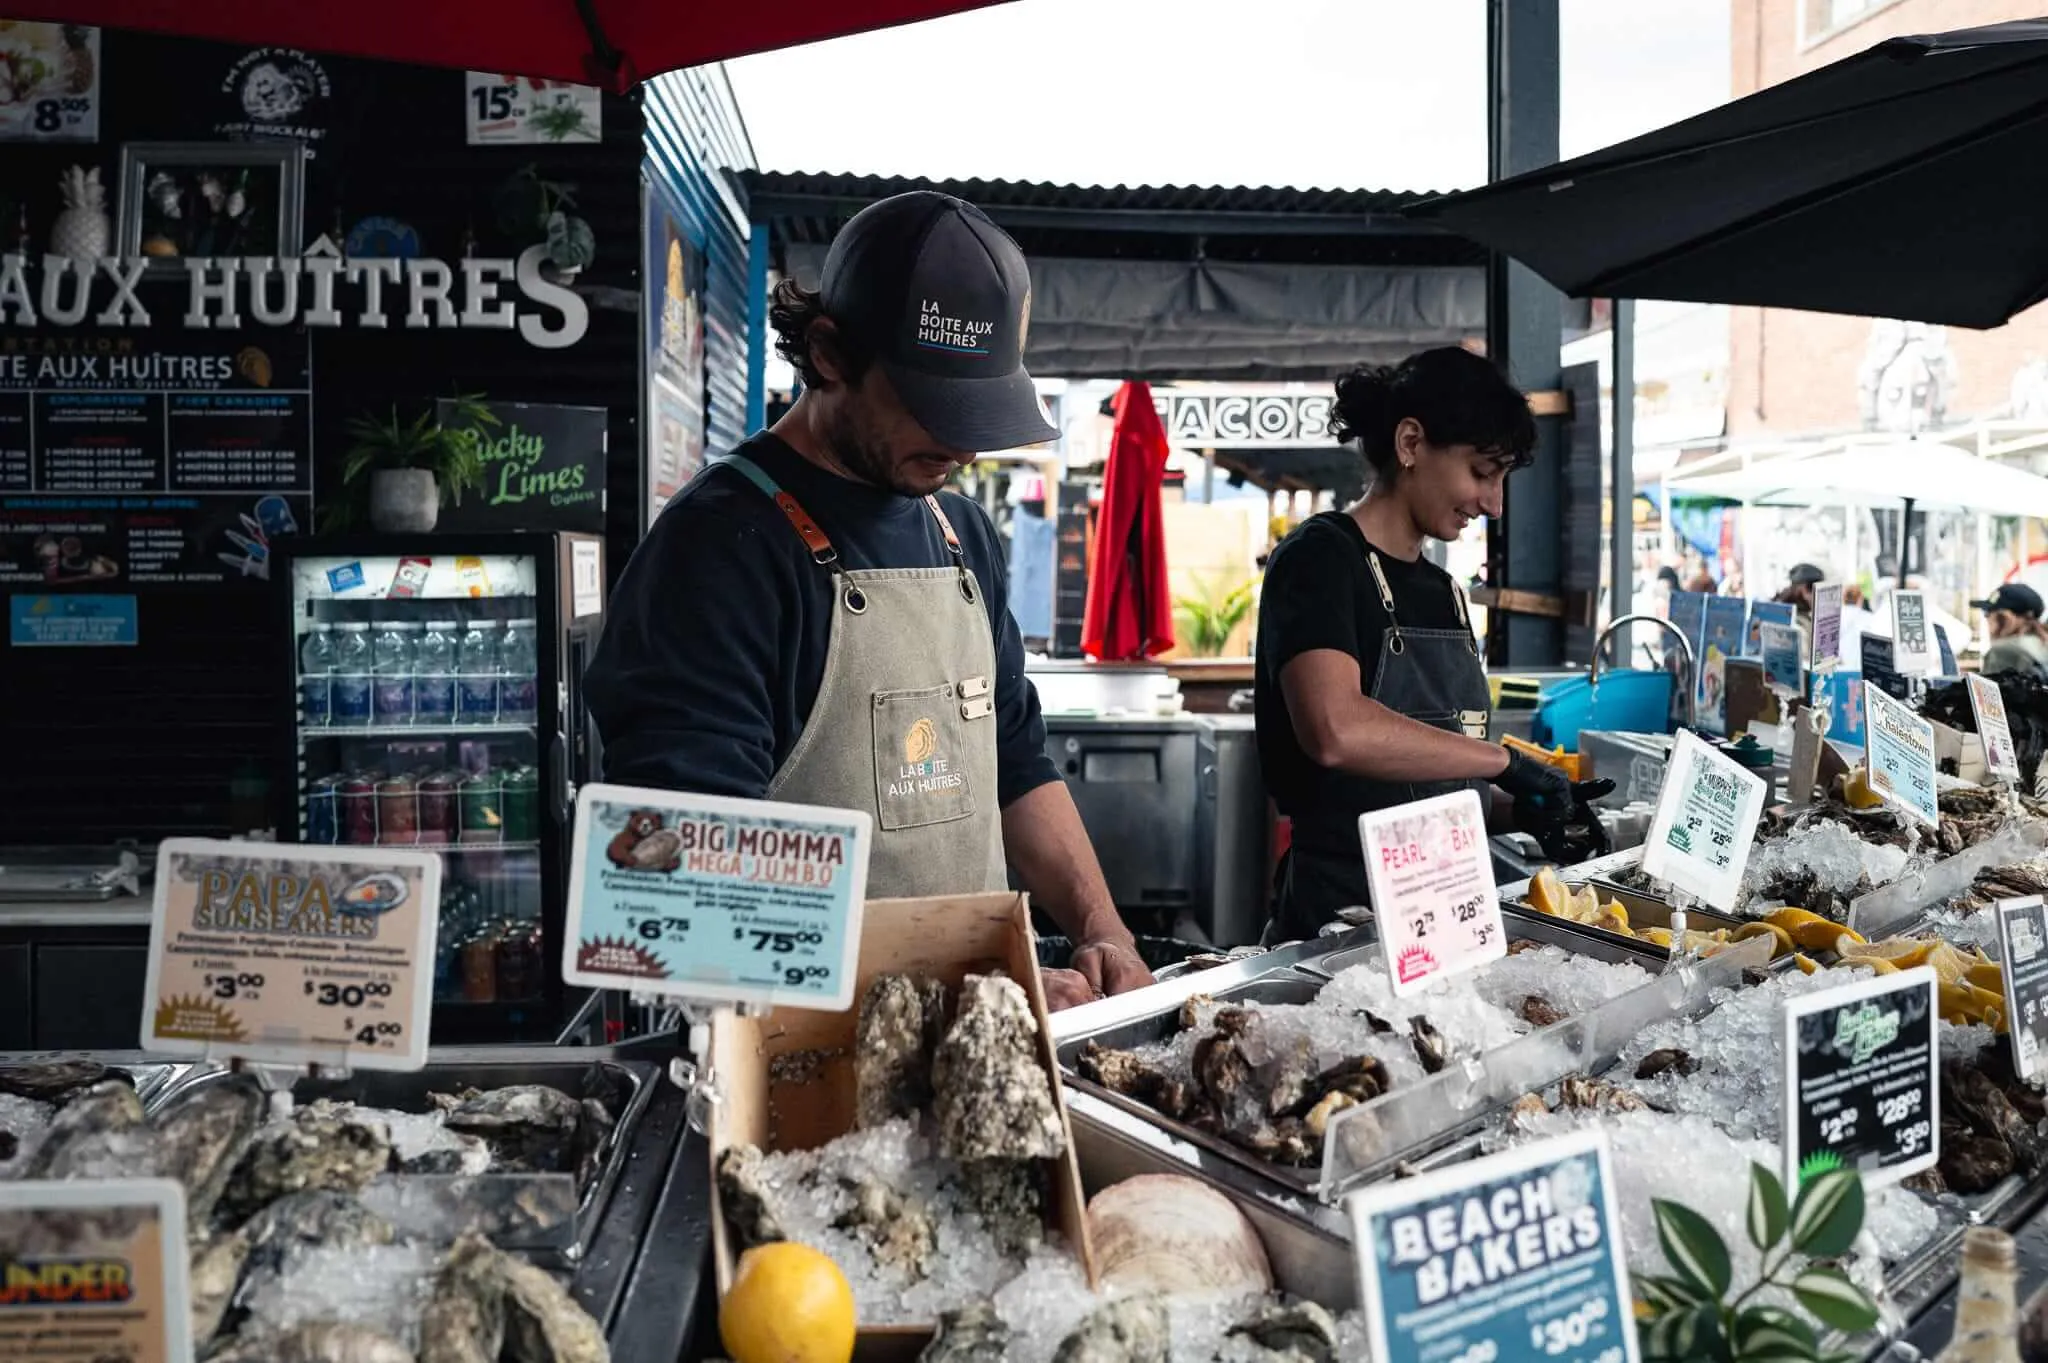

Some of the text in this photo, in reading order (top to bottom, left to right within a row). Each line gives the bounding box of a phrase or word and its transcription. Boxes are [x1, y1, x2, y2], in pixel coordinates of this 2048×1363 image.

[0, 252, 151, 327] AUX
[183, 232, 589, 348] HUÎTRES
[922, 299, 940, 314] LA
[919, 327, 977, 348] HUÎTRES
[920, 313, 993, 335] BOITE AUX
[38, 355, 98, 379] AUX
[109, 352, 233, 380] HUÎTRES
[489, 461, 585, 506] Limes
[889, 780, 915, 796] AUX
[900, 764, 916, 778] LA
[680, 821, 844, 865] BIG MOMMA
[1381, 827, 1478, 871] PEARL BAY
[688, 853, 834, 886] MEGA JUMBO
[200, 870, 334, 916] PAPA
[1391, 1176, 1553, 1266] BEACH
[1415, 1204, 1600, 1305] BAKERS
